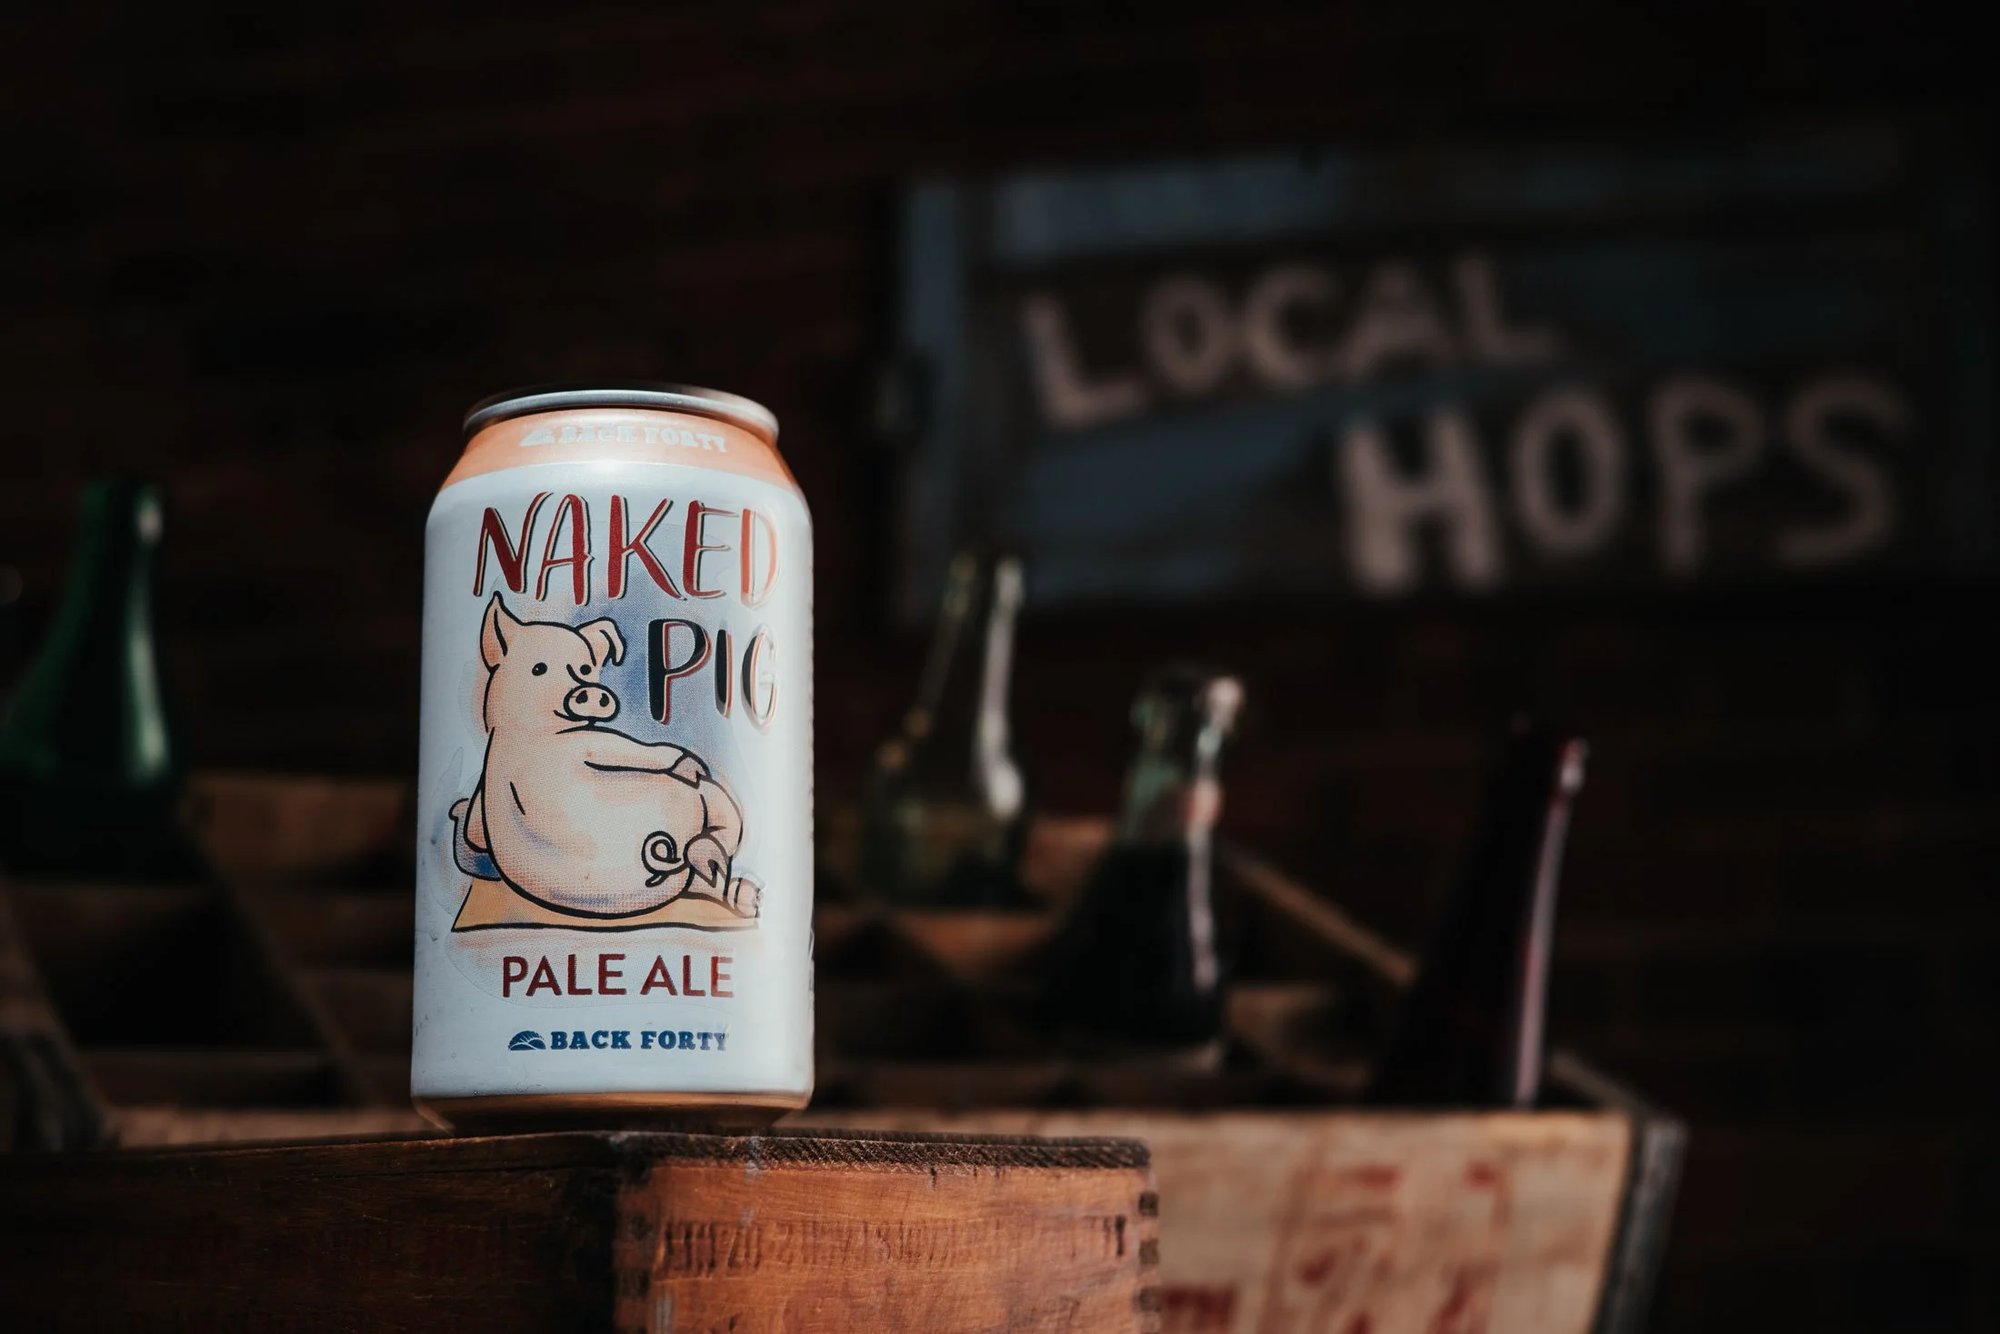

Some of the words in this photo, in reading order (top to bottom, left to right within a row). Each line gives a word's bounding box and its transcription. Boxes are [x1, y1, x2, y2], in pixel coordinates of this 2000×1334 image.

[1018, 250, 1563, 430] LOCAL
[1334, 372, 1908, 593] HOPS
[473, 491, 779, 607] NAKED
[647, 619, 779, 732] PIG
[502, 953, 627, 998] PALE
[640, 953, 735, 998] ALE
[550, 1030, 632, 1050] BACK
[640, 1030, 727, 1051] FORTY
